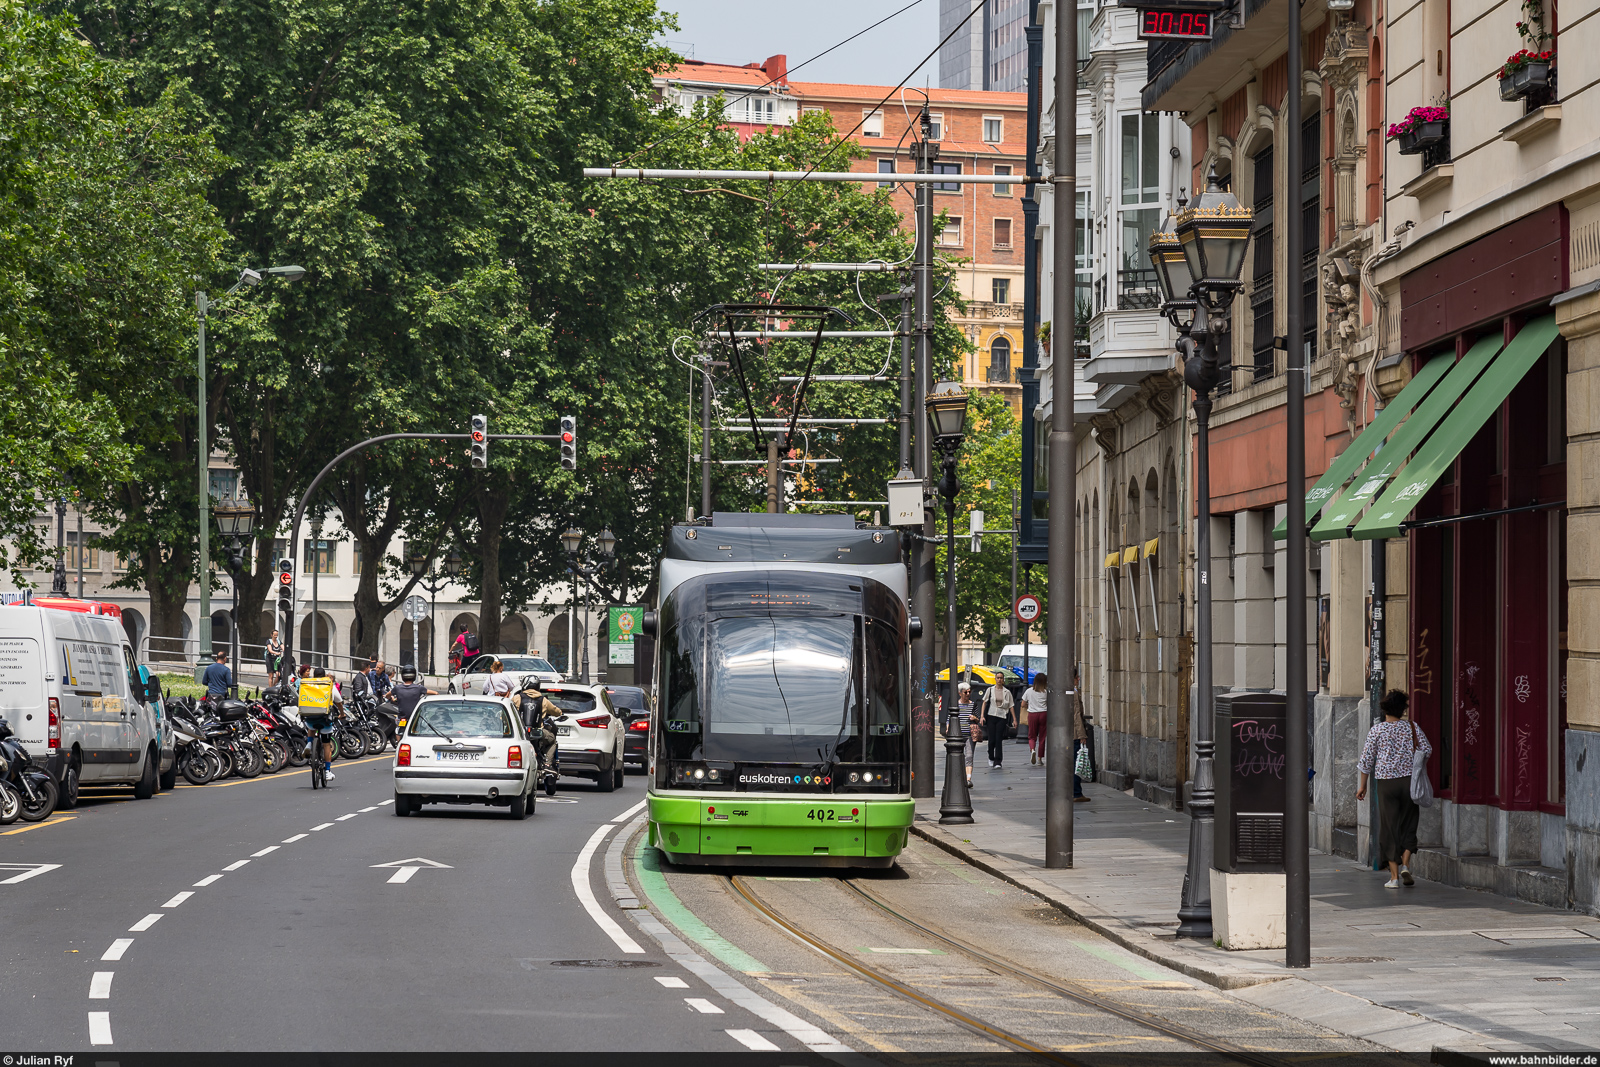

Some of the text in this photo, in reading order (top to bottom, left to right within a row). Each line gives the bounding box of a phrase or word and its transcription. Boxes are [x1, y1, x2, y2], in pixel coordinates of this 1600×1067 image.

[1144, 12, 1208, 36] 30-05
[301, 695, 325, 703] Glovo
[739, 774, 791, 784] euskotren
[807, 809, 835, 821] 402
